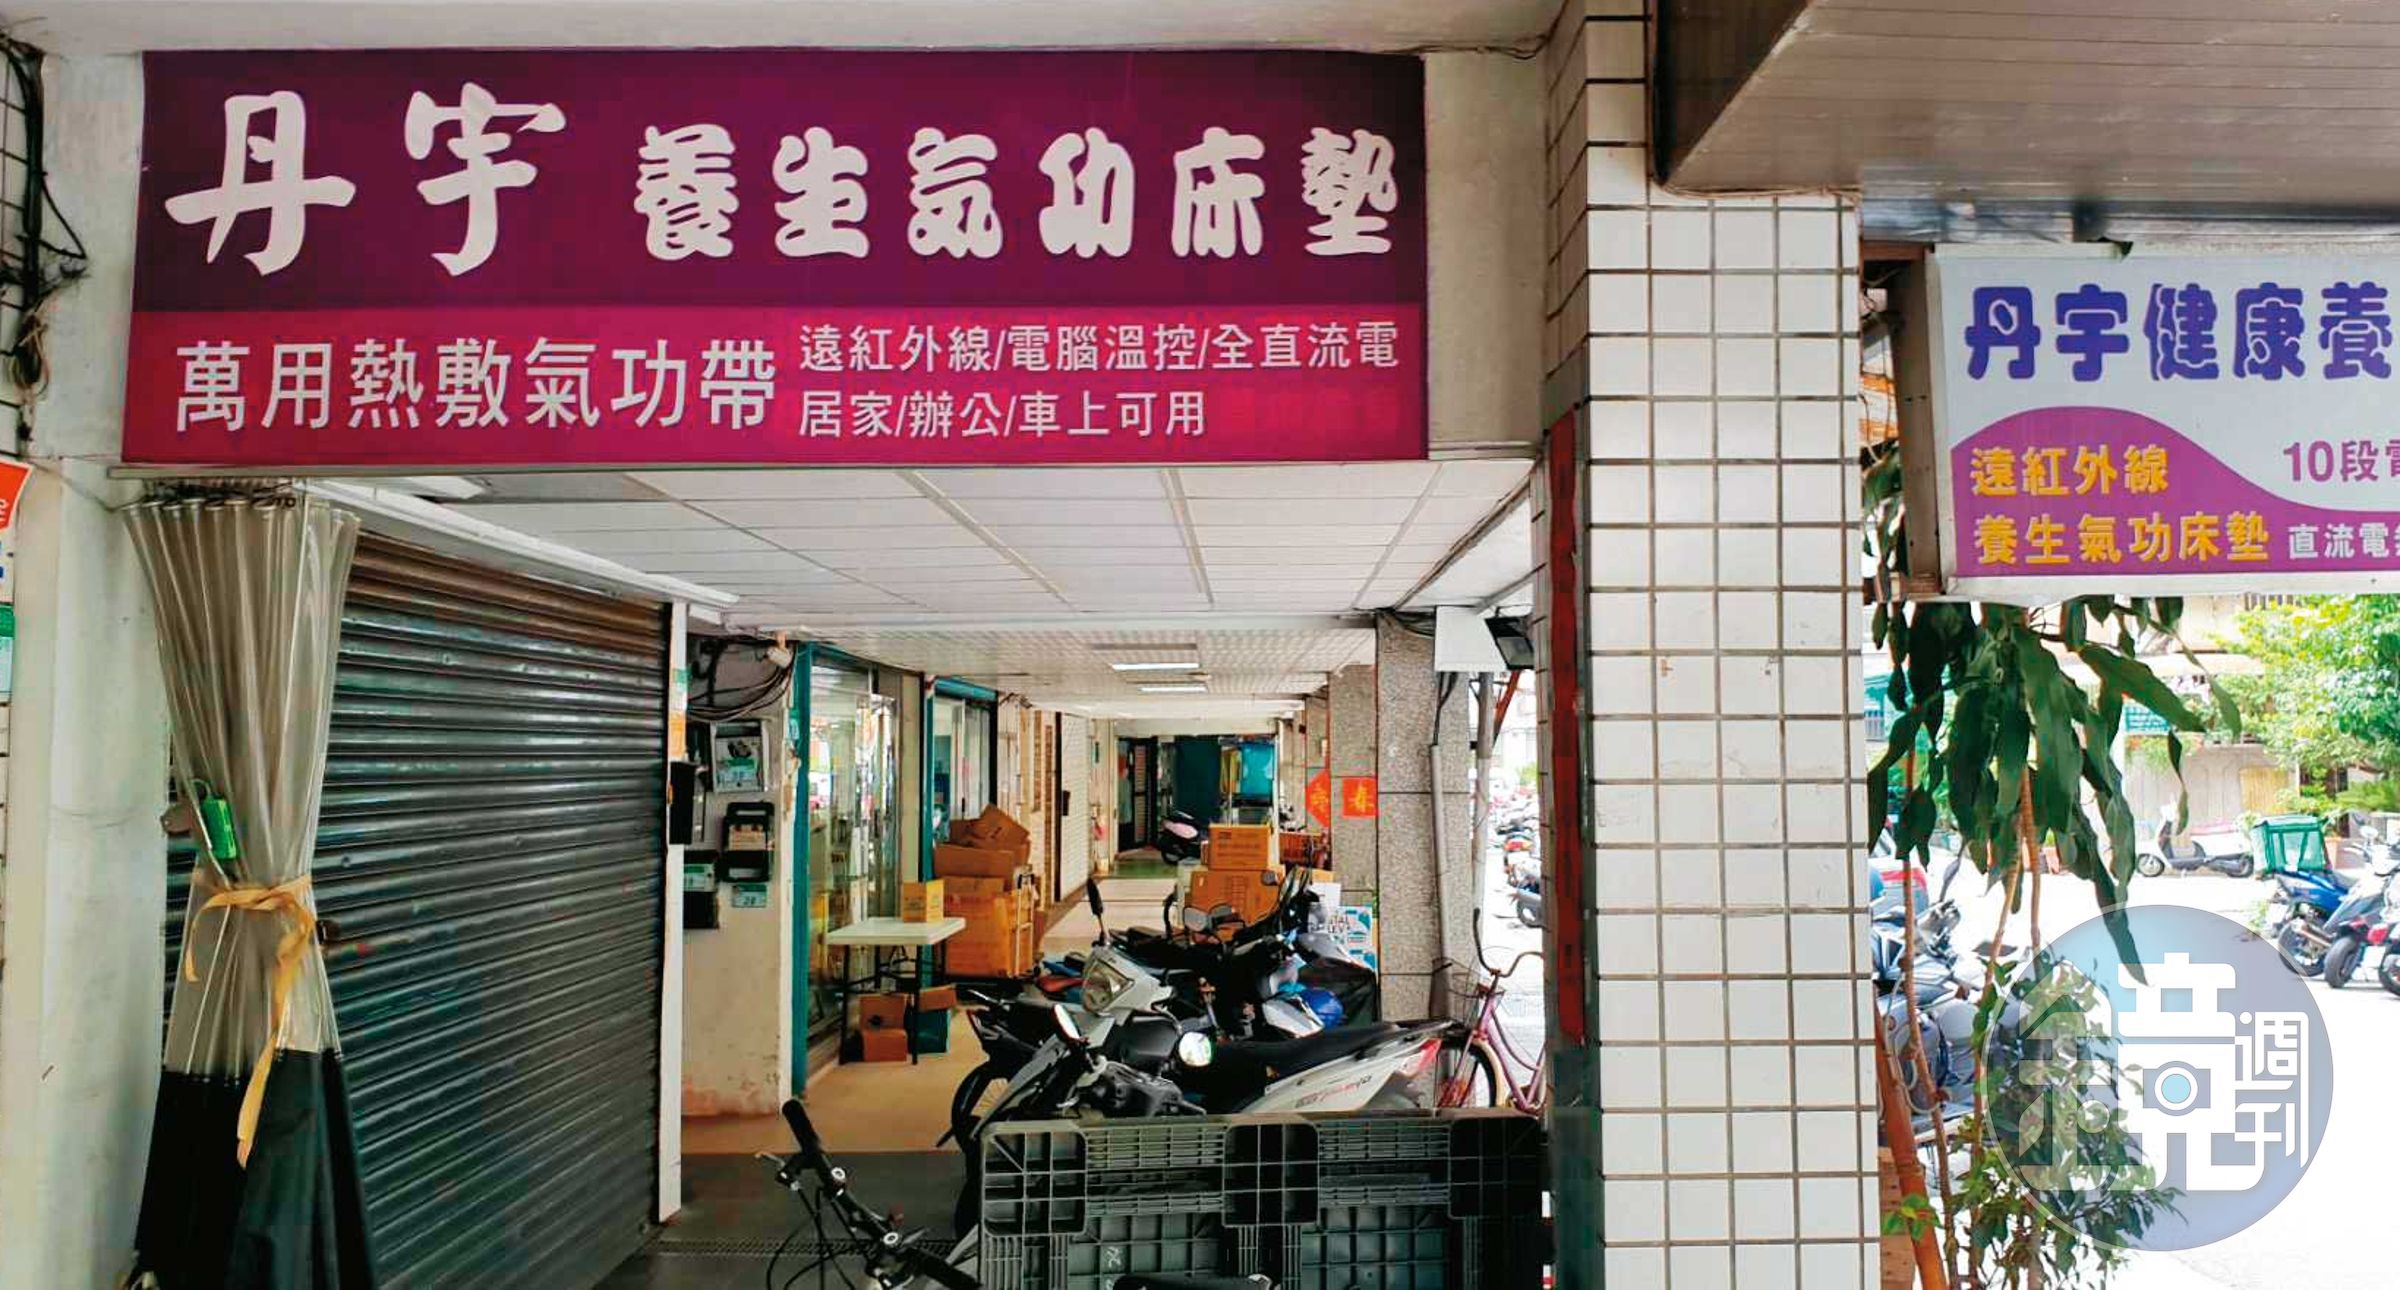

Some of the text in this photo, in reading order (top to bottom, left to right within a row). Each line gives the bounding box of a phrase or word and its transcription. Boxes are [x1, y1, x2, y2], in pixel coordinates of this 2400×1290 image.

[164, 82, 567, 276] 丹宇
[799, 321, 1399, 374] 遠紅外線/電腦溫控/全直流電
[1965, 281, 2394, 382] 丹宇健康養
[176, 336, 777, 432] 萬用熱敷氣功帶
[798, 389, 1206, 439] 居家/辦公/車上可用
[1969, 444, 2170, 497] 遠紅外線
[1973, 511, 2269, 565] 養生氣功床墊
[2288, 521, 2400, 560] 直流電
